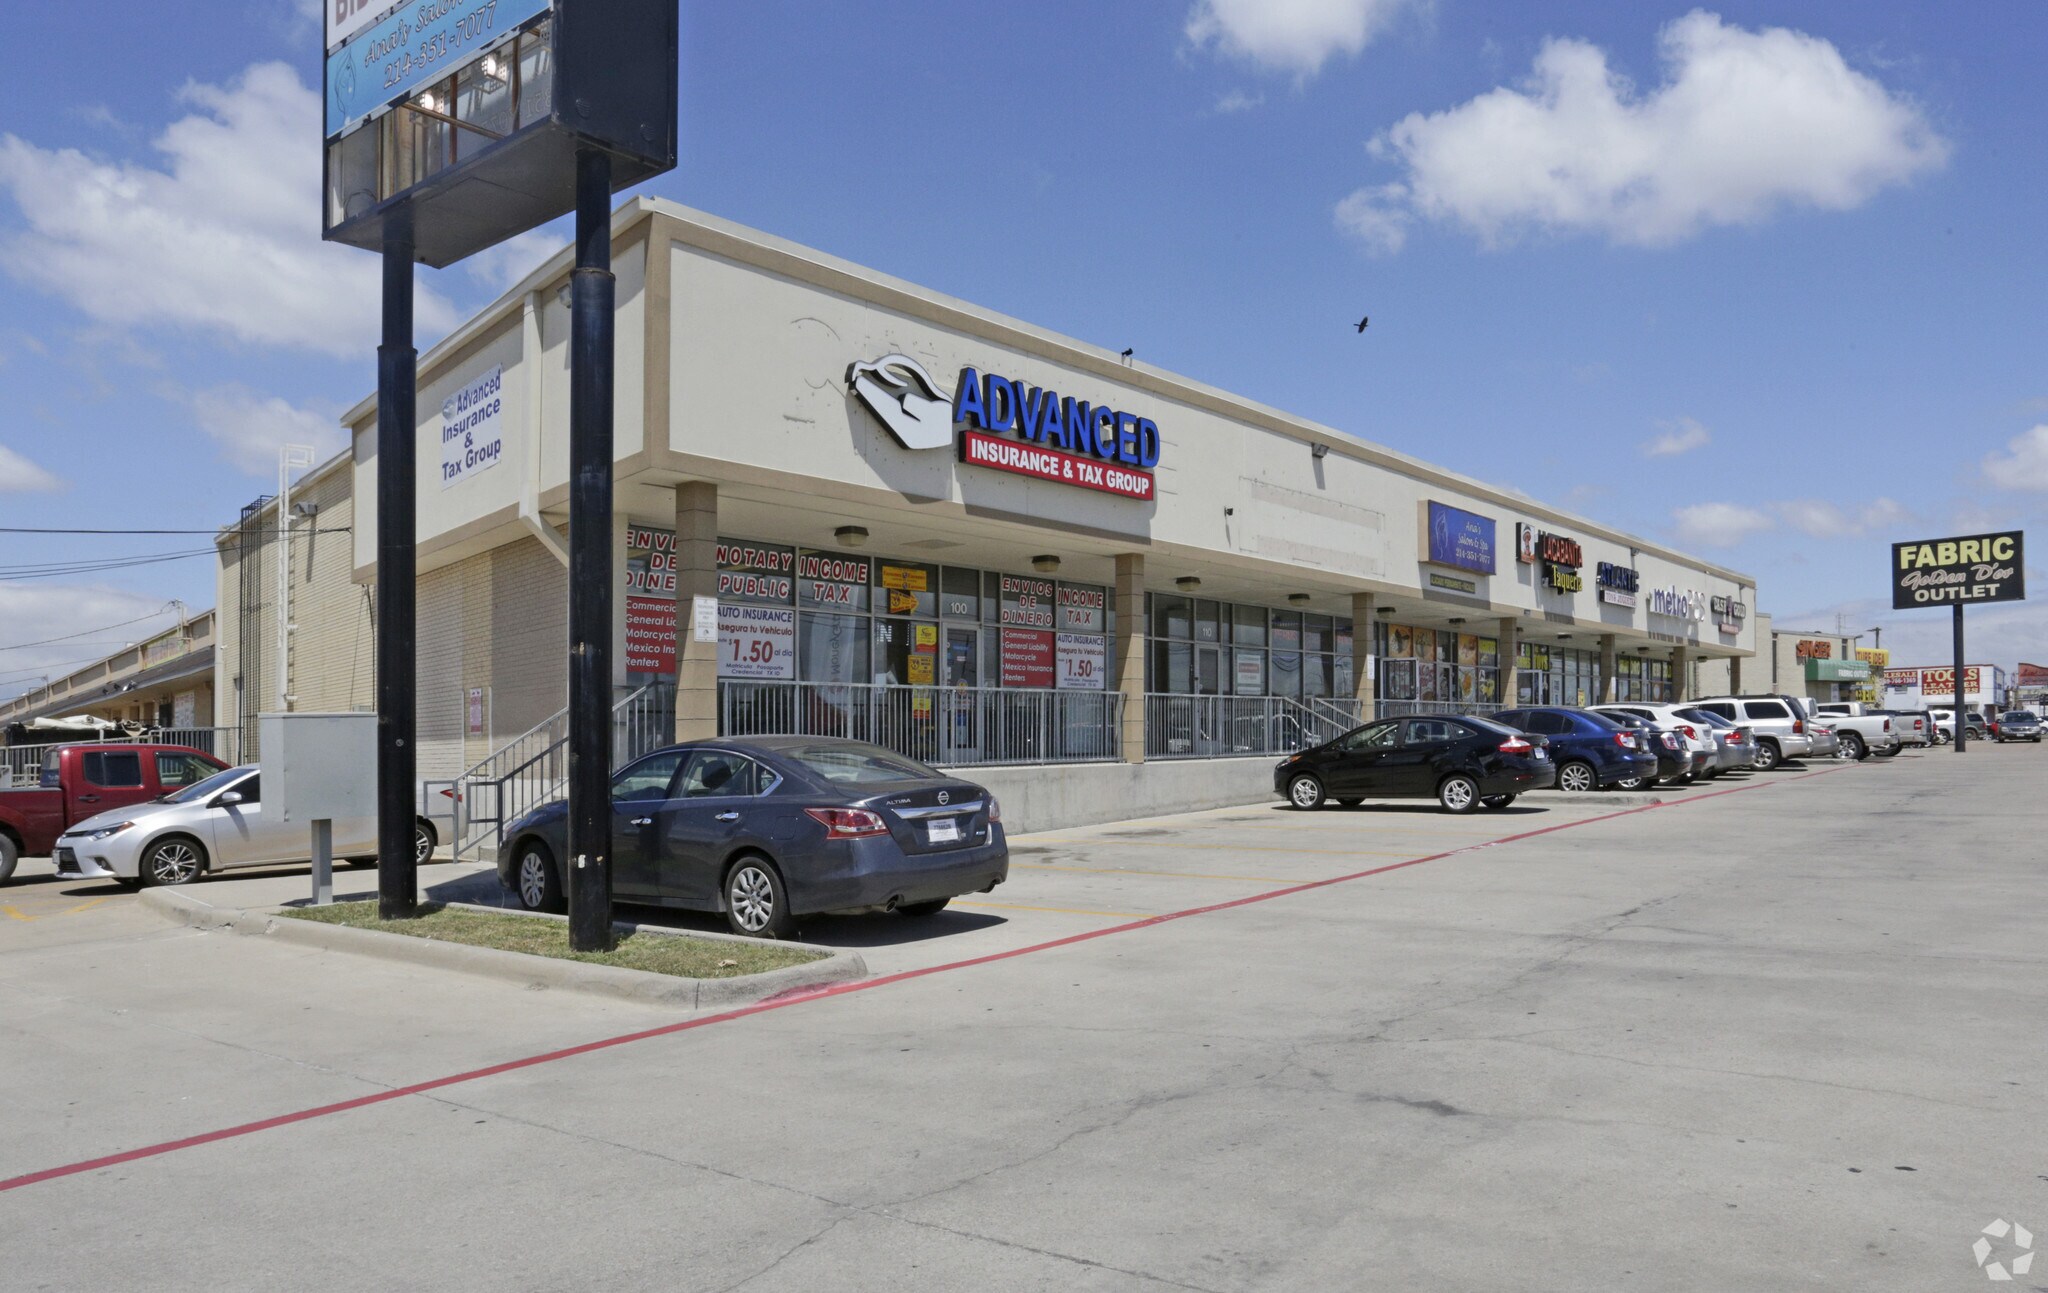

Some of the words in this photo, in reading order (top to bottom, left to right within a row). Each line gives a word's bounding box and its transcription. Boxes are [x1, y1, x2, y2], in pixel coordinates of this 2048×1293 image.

[364, 18, 412, 68] Ana's
[383, 0, 498, 89] 214-351-7077
[456, 369, 501, 415] Advanced
[442, 398, 500, 443] Insurance
[953, 367, 1160, 468] ADVANCED
[464, 431, 473, 449] &
[442, 459, 462, 480] Tax
[465, 438, 501, 469] Group
[971, 438, 1059, 476] INSURANCE
[1063, 459, 1073, 479] &
[1077, 463, 1103, 485] TAX
[1106, 469, 1150, 495] GROUP
[1465, 521, 1481, 535] Ana's
[1458, 532, 1474, 546] Salon
[717, 545, 793, 571] NOTARY
[1900, 536, 2014, 569] FABRIC
[651, 553, 676, 571] DE
[799, 556, 868, 583] INCOME
[718, 574, 790, 599] PUBLIC
[1002, 578, 1053, 597] ENVIOS
[1900, 569, 1966, 590] Golden
[813, 582, 851, 603] TAX
[1057, 588, 1103, 608] INCOME
[1914, 583, 2000, 602] OUTLET
[950, 602, 967, 614] 100
[1019, 595, 1036, 609] DE
[626, 614, 664, 626] General
[742, 608, 793, 623] INSURANCE
[1002, 609, 1053, 626] DINERO
[1067, 609, 1092, 624] TAX
[750, 625, 757, 633] tu
[1004, 631, 1037, 640] Commercial
[1202, 627, 1211, 637] 110
[626, 642, 660, 654] Mexico
[1004, 641, 1028, 650] General
[1029, 643, 1049, 653] Liability
[1057, 635, 1072, 643] AUTO
[1073, 635, 1104, 646] INSURANCE
[626, 656, 659, 667] Renters
[1004, 652, 1037, 662] Motorcycle
[1004, 663, 1026, 671] Mexico
[1027, 664, 1054, 673] Insurance
[1923, 668, 1978, 682] TOOS
[1923, 681, 1978, 689] LEATER
